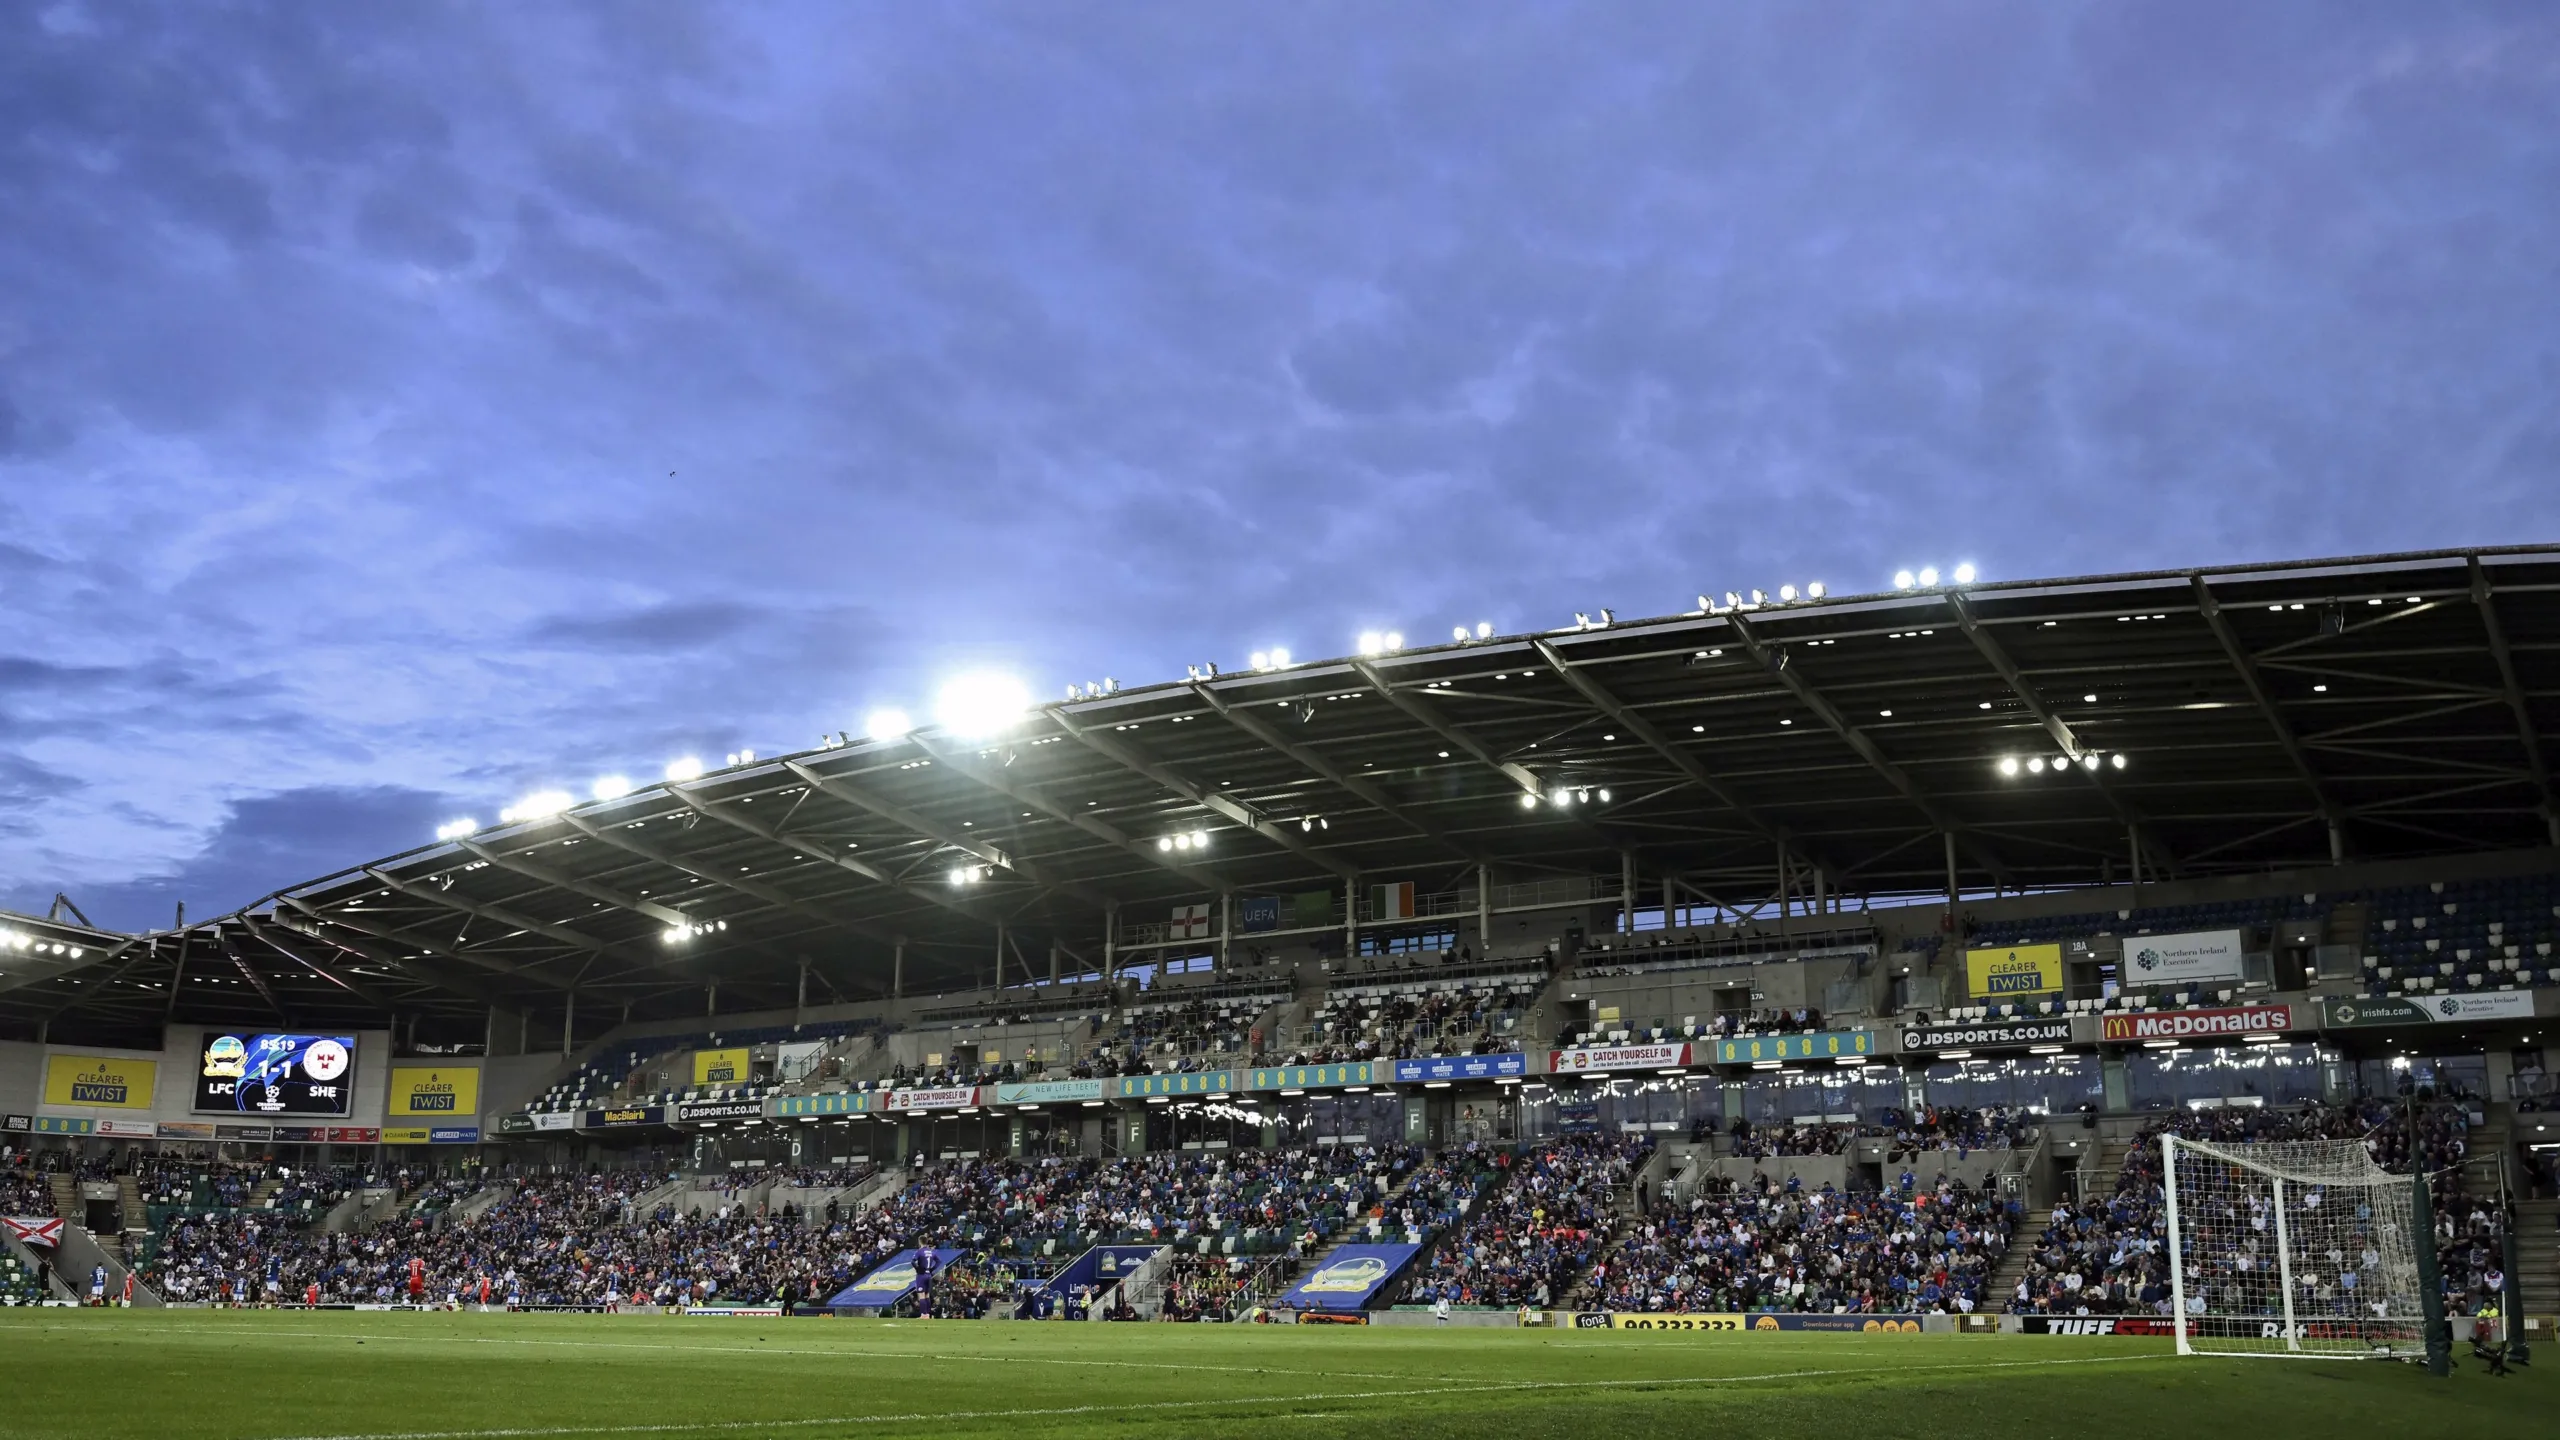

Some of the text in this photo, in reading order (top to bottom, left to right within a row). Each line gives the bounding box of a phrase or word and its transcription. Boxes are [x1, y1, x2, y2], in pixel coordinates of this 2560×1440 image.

[1245, 908, 1275, 922] UEFA
[2072, 941, 2087, 951] 18A
[2162, 946, 2227, 957] Northern Ireland
[1990, 962, 2037, 974] CLEARER
[2162, 957, 2199, 967] Executive
[1991, 975, 2038, 991] TWIST
[2362, 1007, 2412, 1017] irishfa.com
[2136, 1011, 2286, 1036] McDonald's
[1923, 1025, 2068, 1046] JDSPORTS.CO.UK
[260, 1040, 295, 1050] 85:19
[1593, 1047, 1672, 1061] CATCH YOURSELF ON
[77, 1073, 124, 1085] CLEARER
[709, 1071, 732, 1080] TWIST
[76, 1086, 124, 1101] TWIST
[209, 1083, 337, 1097] LFC SHE
[414, 1084, 453, 1092] CLEARER
[1035, 1082, 1099, 1093] NEW LIFE TEETH
[413, 1096, 452, 1108] TWIST
[914, 1090, 967, 1101] CATCH YOURSELF ON
[1908, 1089, 1924, 1108] H
[605, 1109, 640, 1122] MacBlair
[689, 1104, 761, 1118] JDSPORTS.CO.UK
[9, 1116, 29, 1124] BRICK
[1410, 1113, 1419, 1130] F
[1012, 1132, 1020, 1147] E
[1131, 1126, 1139, 1142] F
[792, 1142, 801, 1157] D
[412, 1266, 418, 1276] 11
[1581, 1314, 1605, 1328] fona
[1843, 1321, 1855, 1329] app
[2047, 1320, 2114, 1335] TUFF
